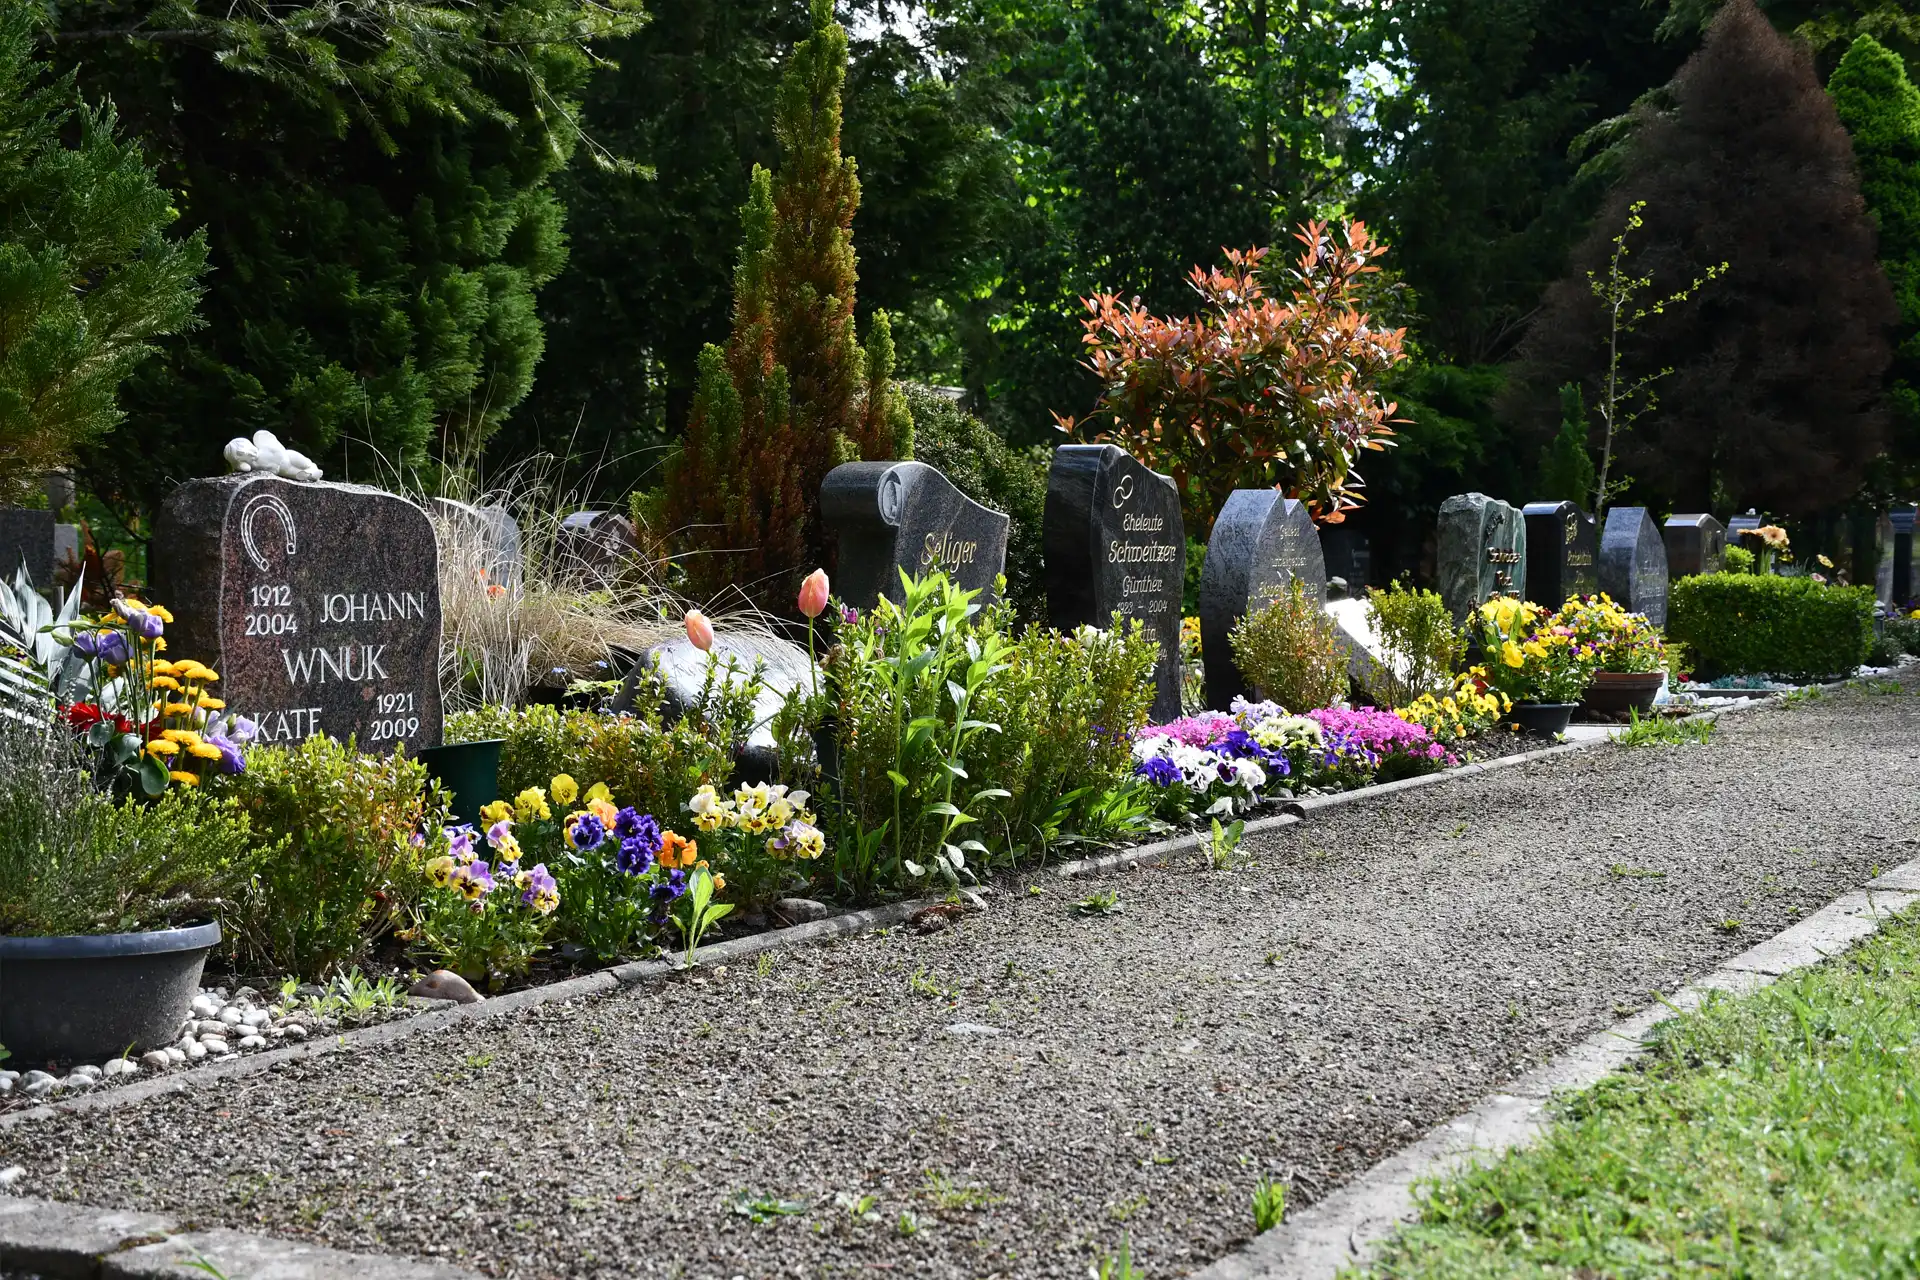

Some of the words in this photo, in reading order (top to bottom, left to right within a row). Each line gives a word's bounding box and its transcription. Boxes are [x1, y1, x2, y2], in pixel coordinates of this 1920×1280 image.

[1123, 513, 1164, 532] Eheleute
[920, 532, 977, 574] Seliger
[1108, 540, 1177, 563] Schweitzer
[250, 584, 292, 608] 1912
[1122, 575, 1163, 598] Günther
[319, 591, 425, 623] JOHANN
[1148, 599, 1168, 613] 2004
[245, 613, 298, 636] 2004
[280, 644, 389, 686] WNUK
[376, 692, 414, 714] 1921
[253, 707, 323, 743] KÄTE
[370, 717, 420, 741] 2009
